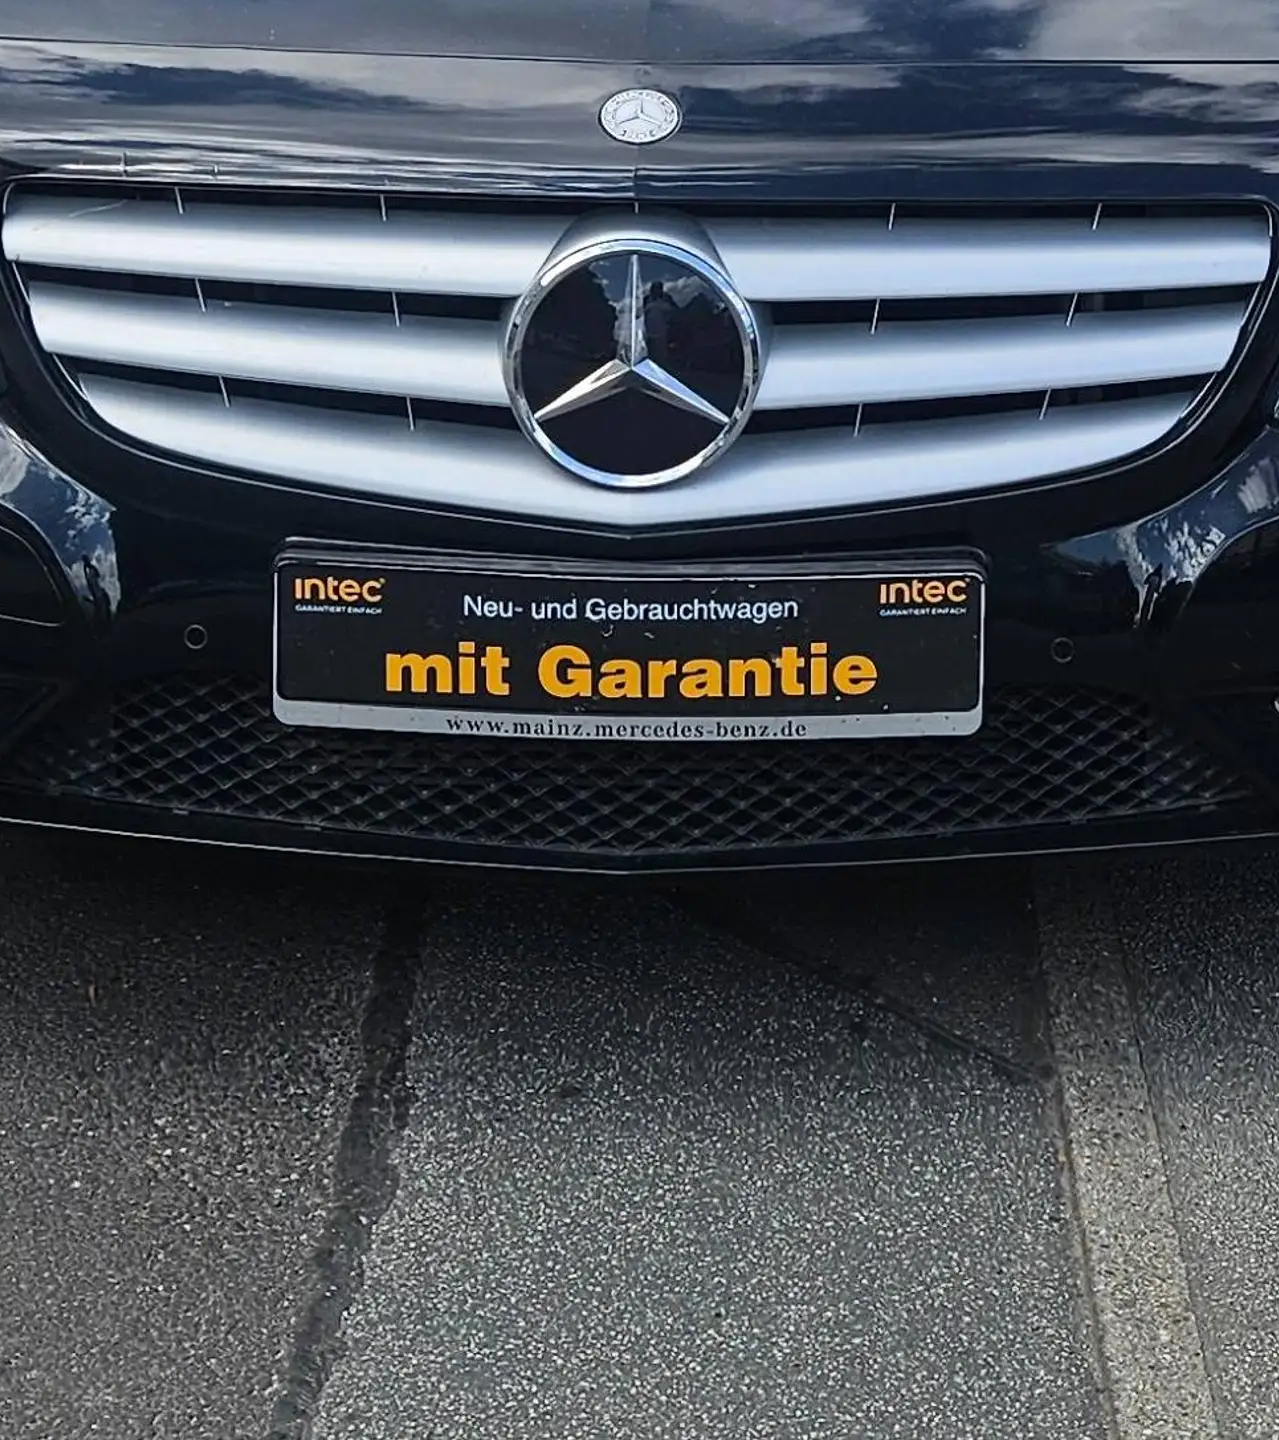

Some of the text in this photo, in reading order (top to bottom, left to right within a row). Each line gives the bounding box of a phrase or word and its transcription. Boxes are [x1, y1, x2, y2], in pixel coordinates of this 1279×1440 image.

[295, 576, 383, 603] intec
[880, 579, 967, 604] intec
[463, 594, 799, 624] Neu- und Gebrauchtwagen
[384, 641, 880, 699] mit Garantie
[446, 715, 807, 739] www.mainz.mercedes-benz.de
